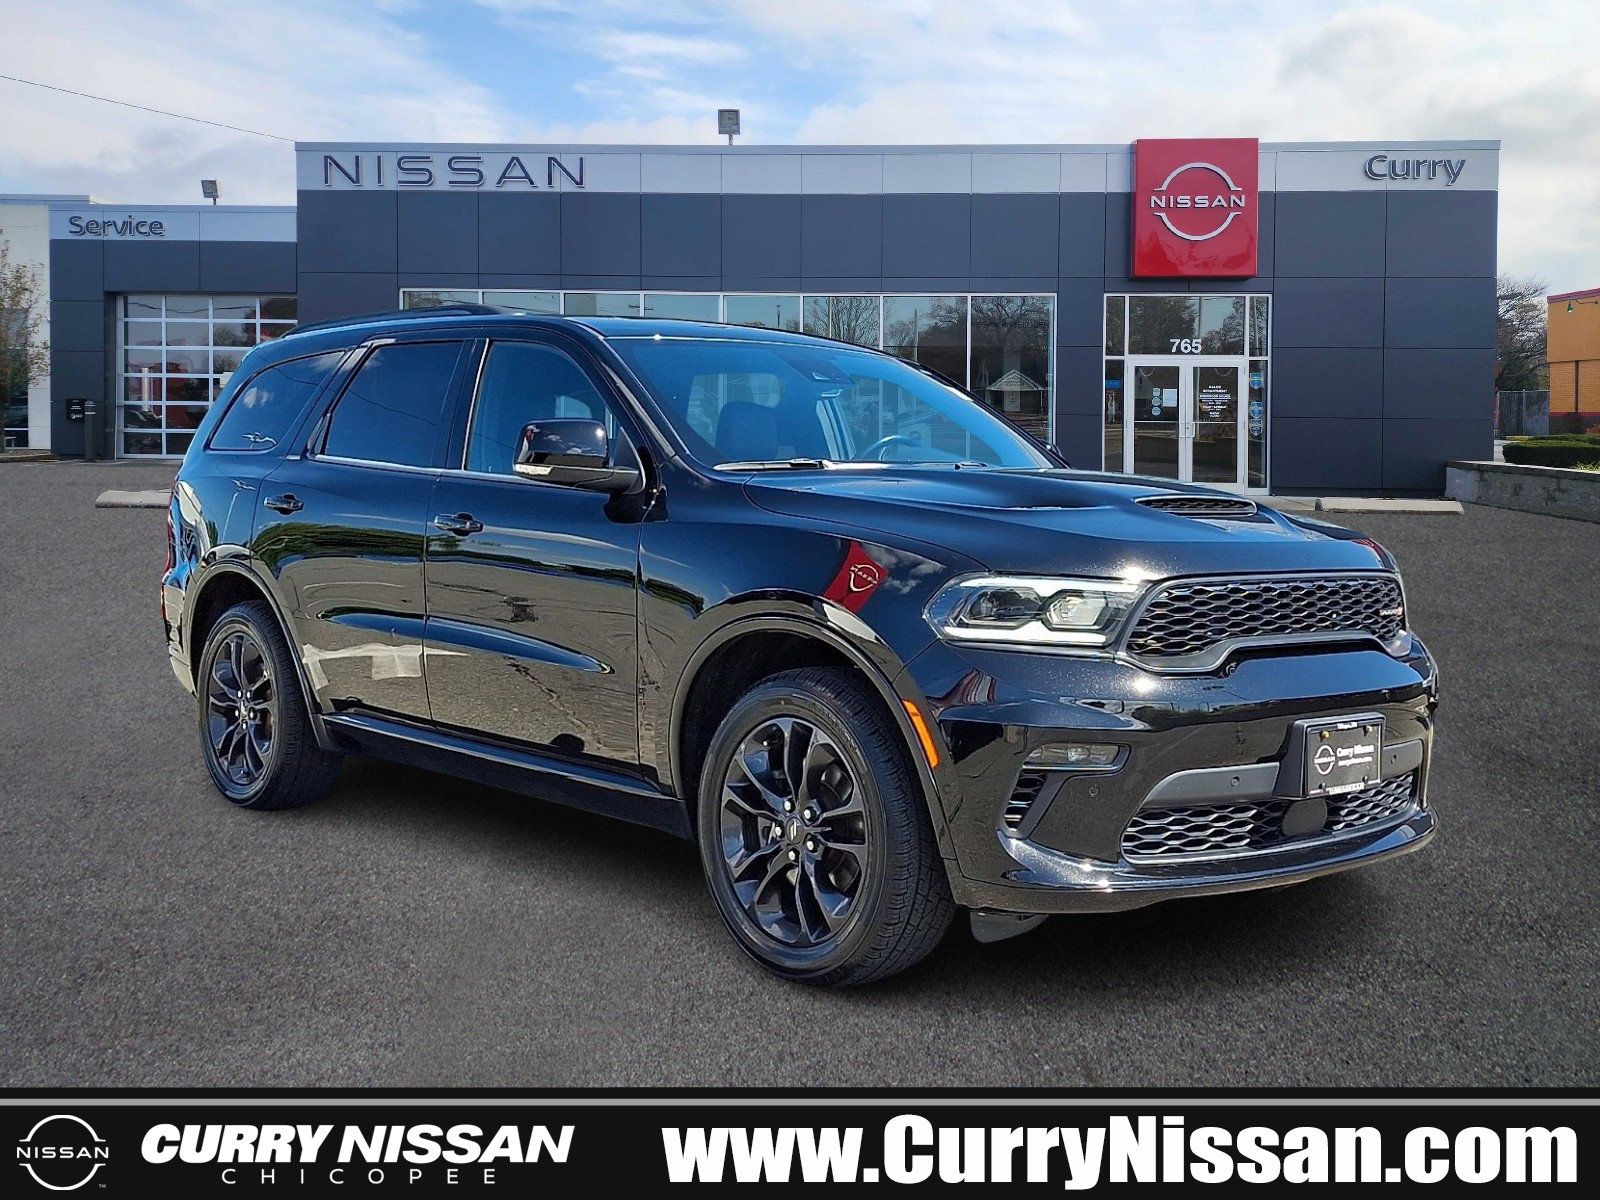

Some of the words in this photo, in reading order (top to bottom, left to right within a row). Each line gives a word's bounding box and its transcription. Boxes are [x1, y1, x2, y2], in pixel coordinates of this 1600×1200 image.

[323, 155, 585, 188] NISSAN
[1364, 154, 1466, 187] Curry
[1150, 194, 1246, 208] NISSAN
[69, 214, 165, 236] Service
[1169, 338, 1203, 354] 765
